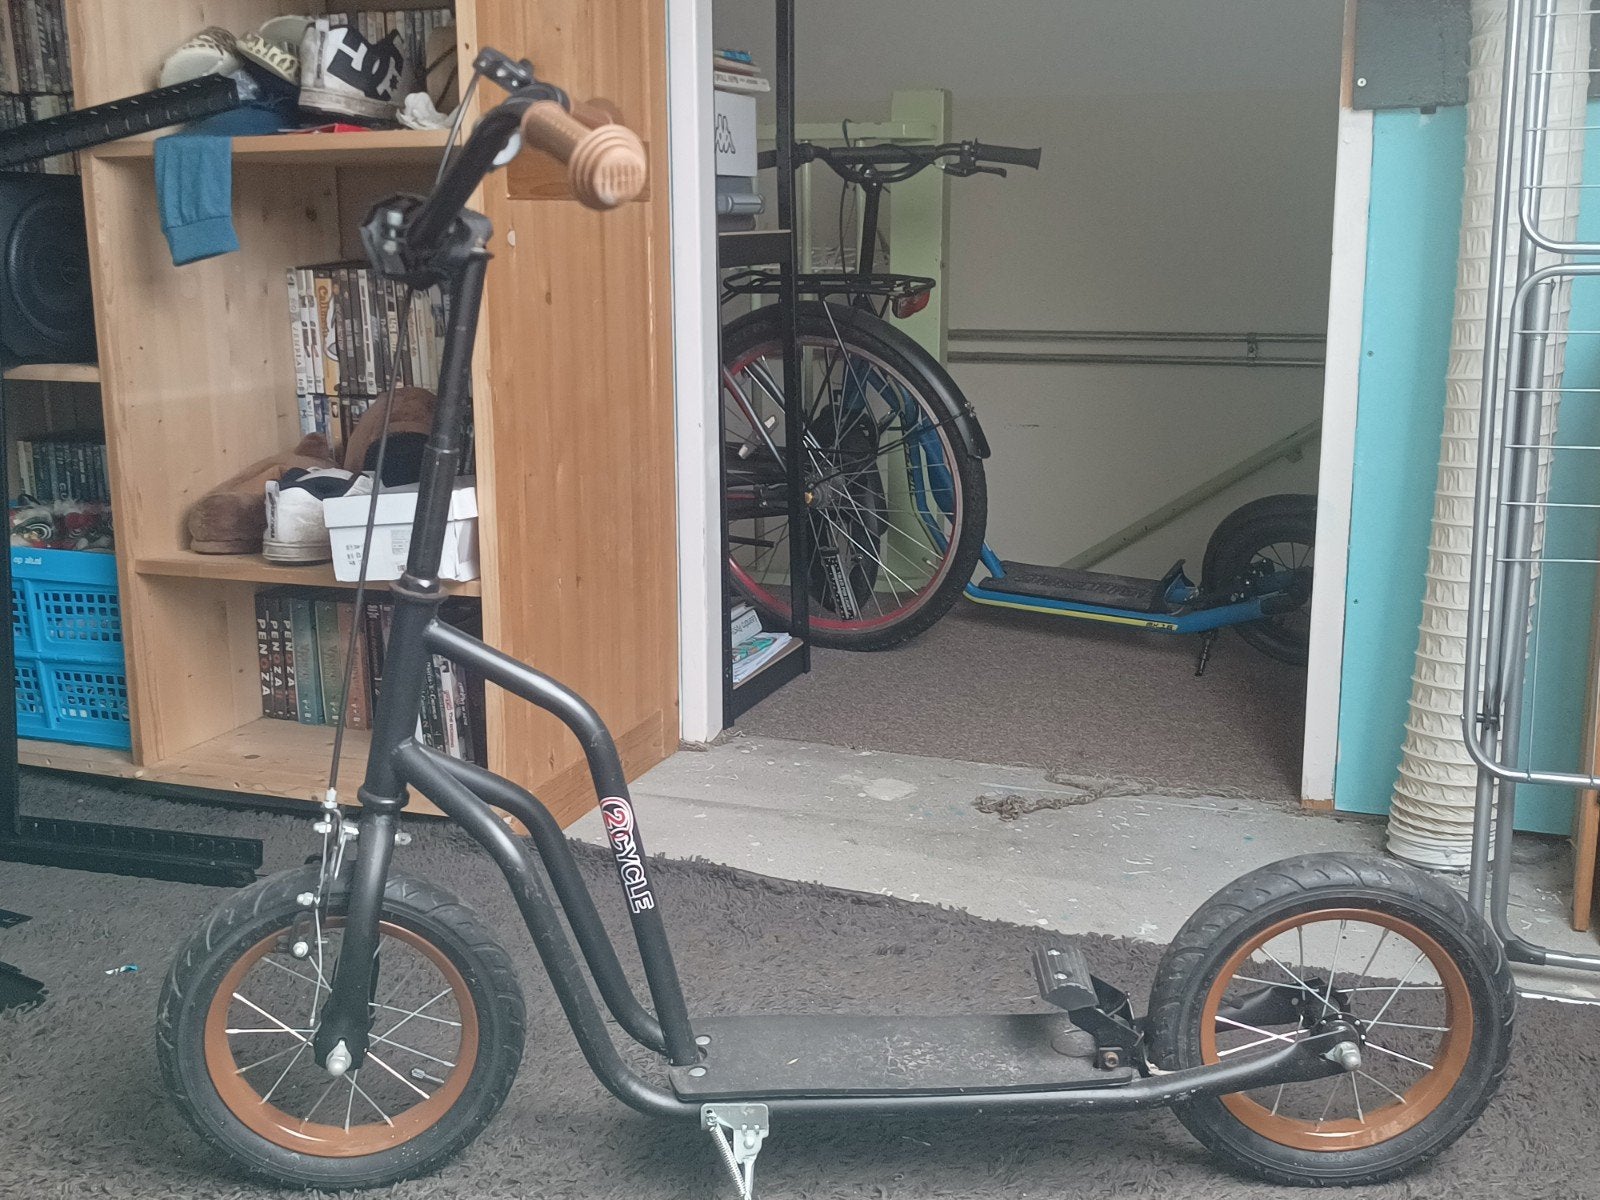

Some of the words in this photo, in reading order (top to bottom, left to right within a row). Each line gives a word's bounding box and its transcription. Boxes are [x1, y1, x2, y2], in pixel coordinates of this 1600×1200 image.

[257, 618, 271, 696] PENOZA
[270, 620, 283, 687] PENOZA
[283, 620, 295, 687] PENOZA
